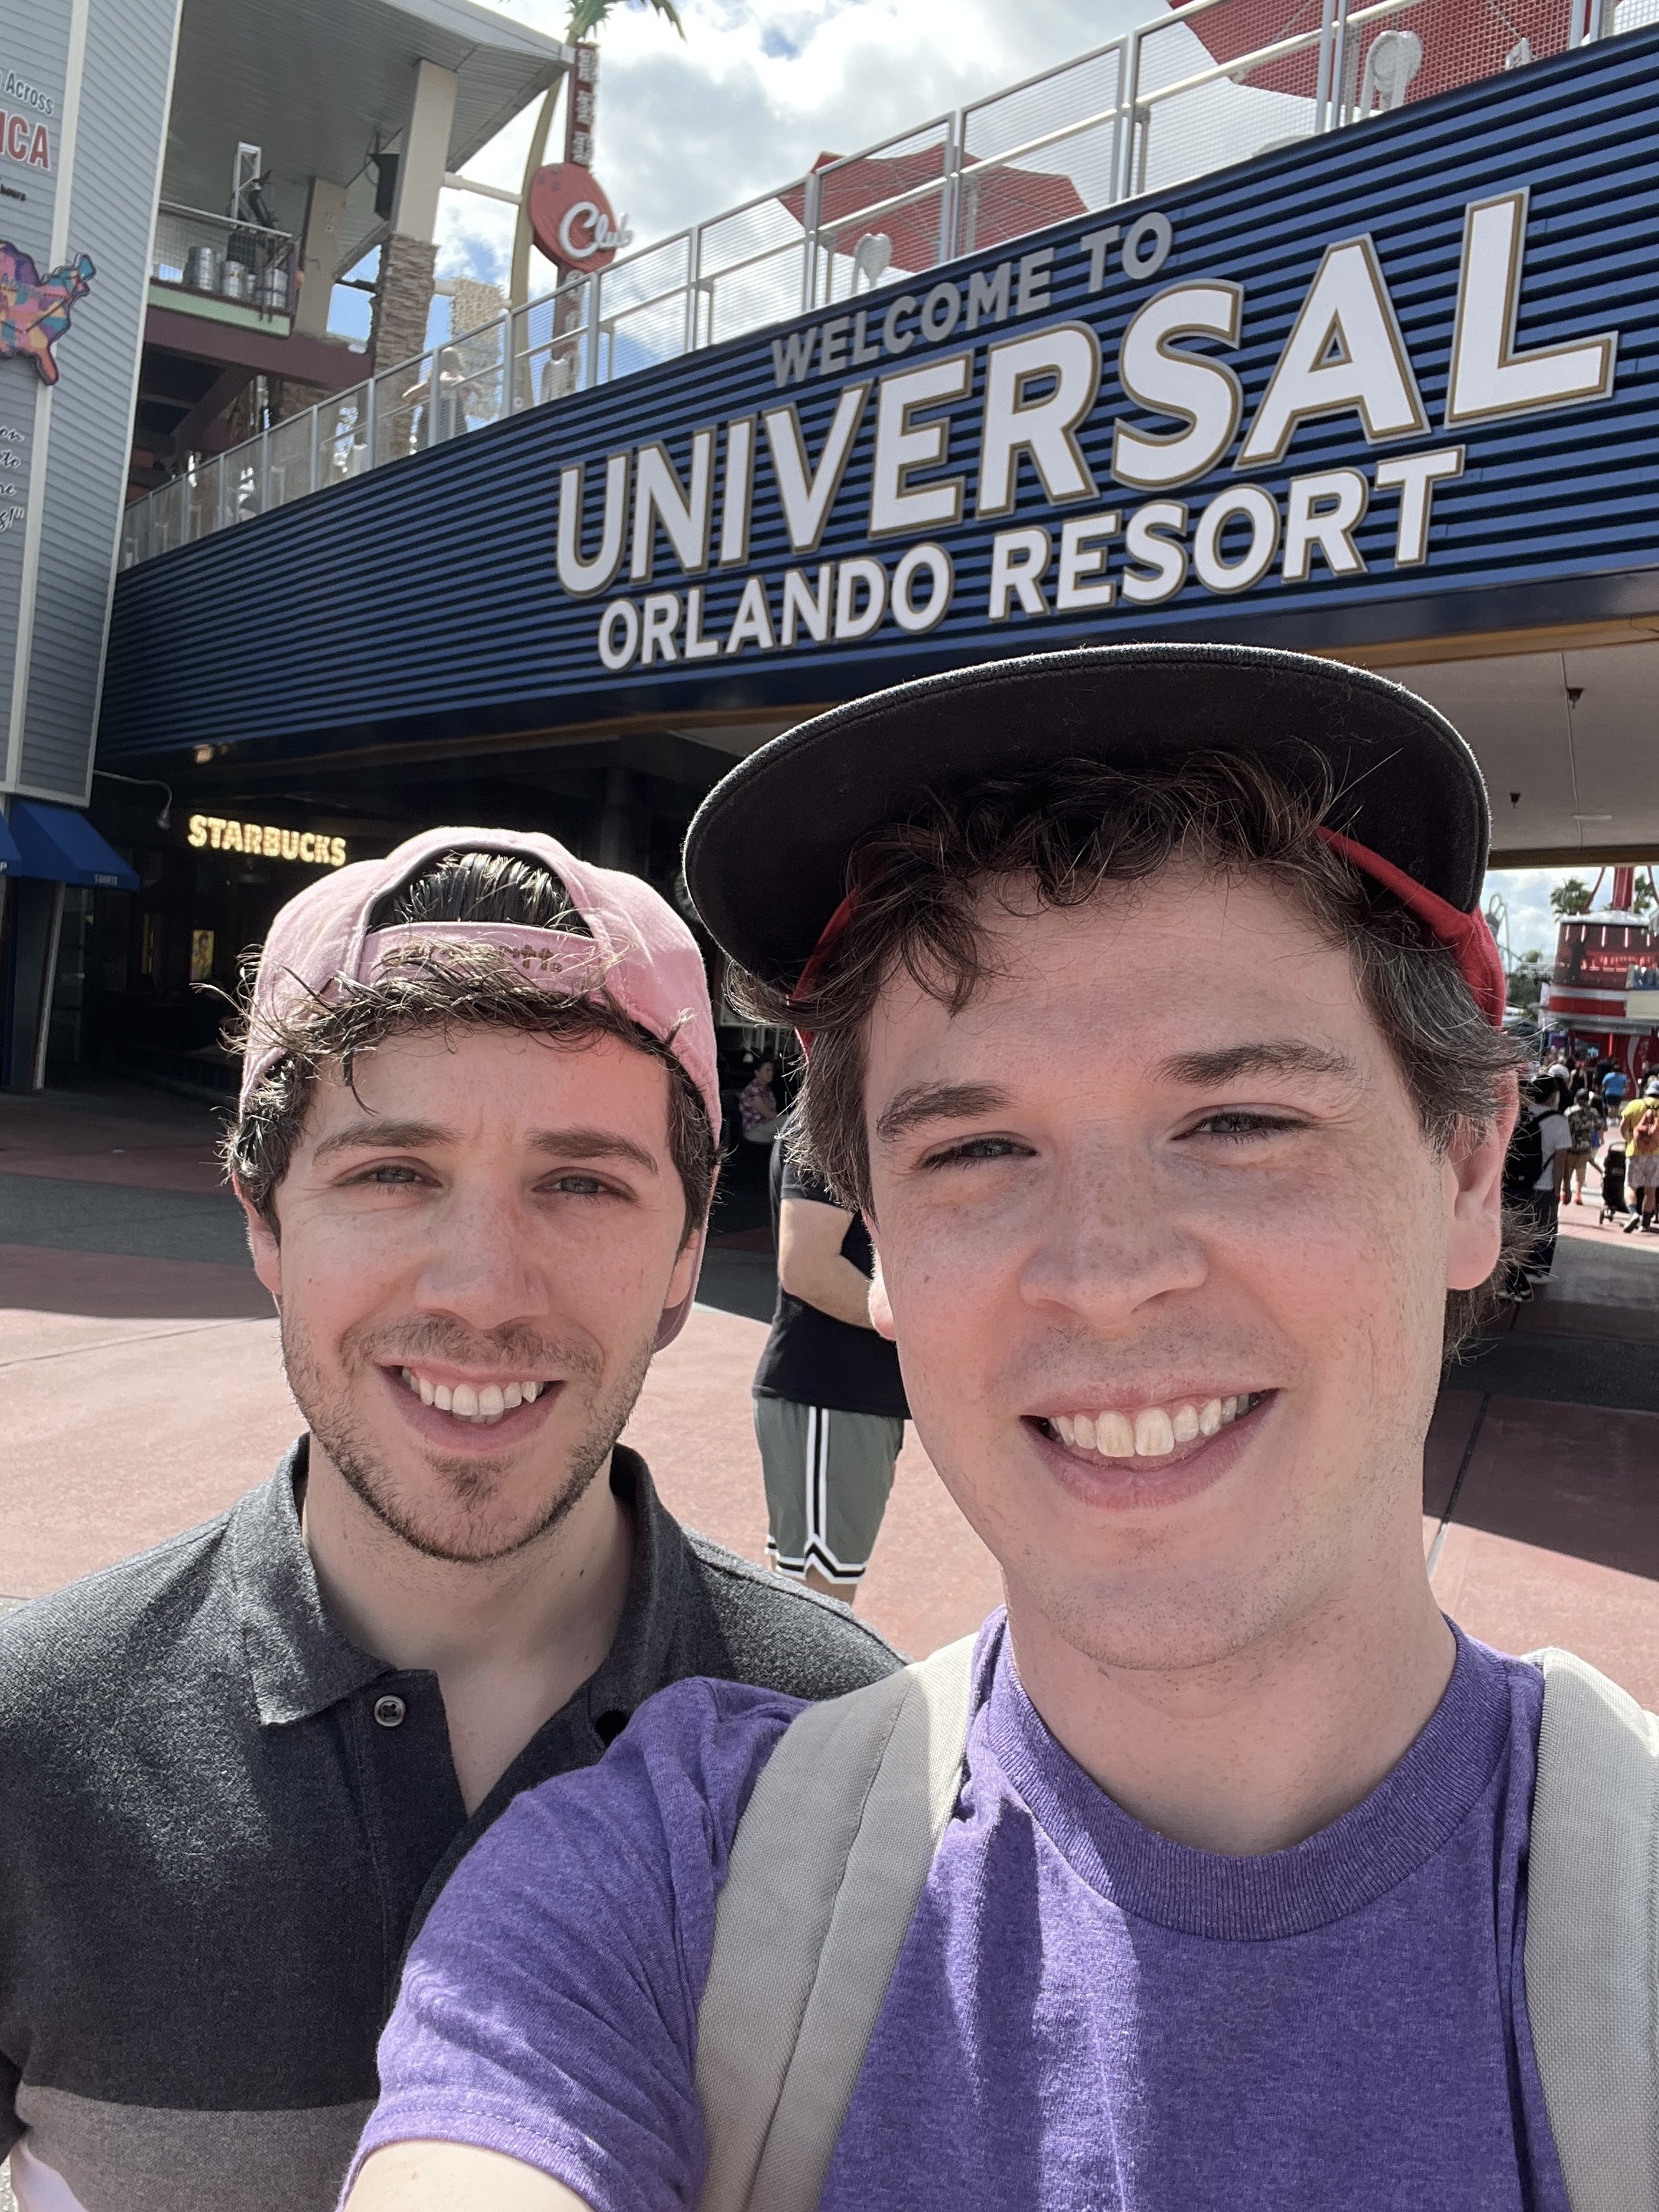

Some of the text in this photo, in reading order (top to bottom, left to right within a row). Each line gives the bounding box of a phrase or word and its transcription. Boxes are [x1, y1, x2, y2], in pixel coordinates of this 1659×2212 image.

[4, 70, 54, 116] Across
[559, 201, 634, 260] Club
[771, 211, 1173, 388] WELCOME TO
[557, 185, 1620, 597] UNIVERSAL
[597, 444, 1466, 673] ORLANDO RESORT
[188, 814, 347, 867] STARBUCKS
